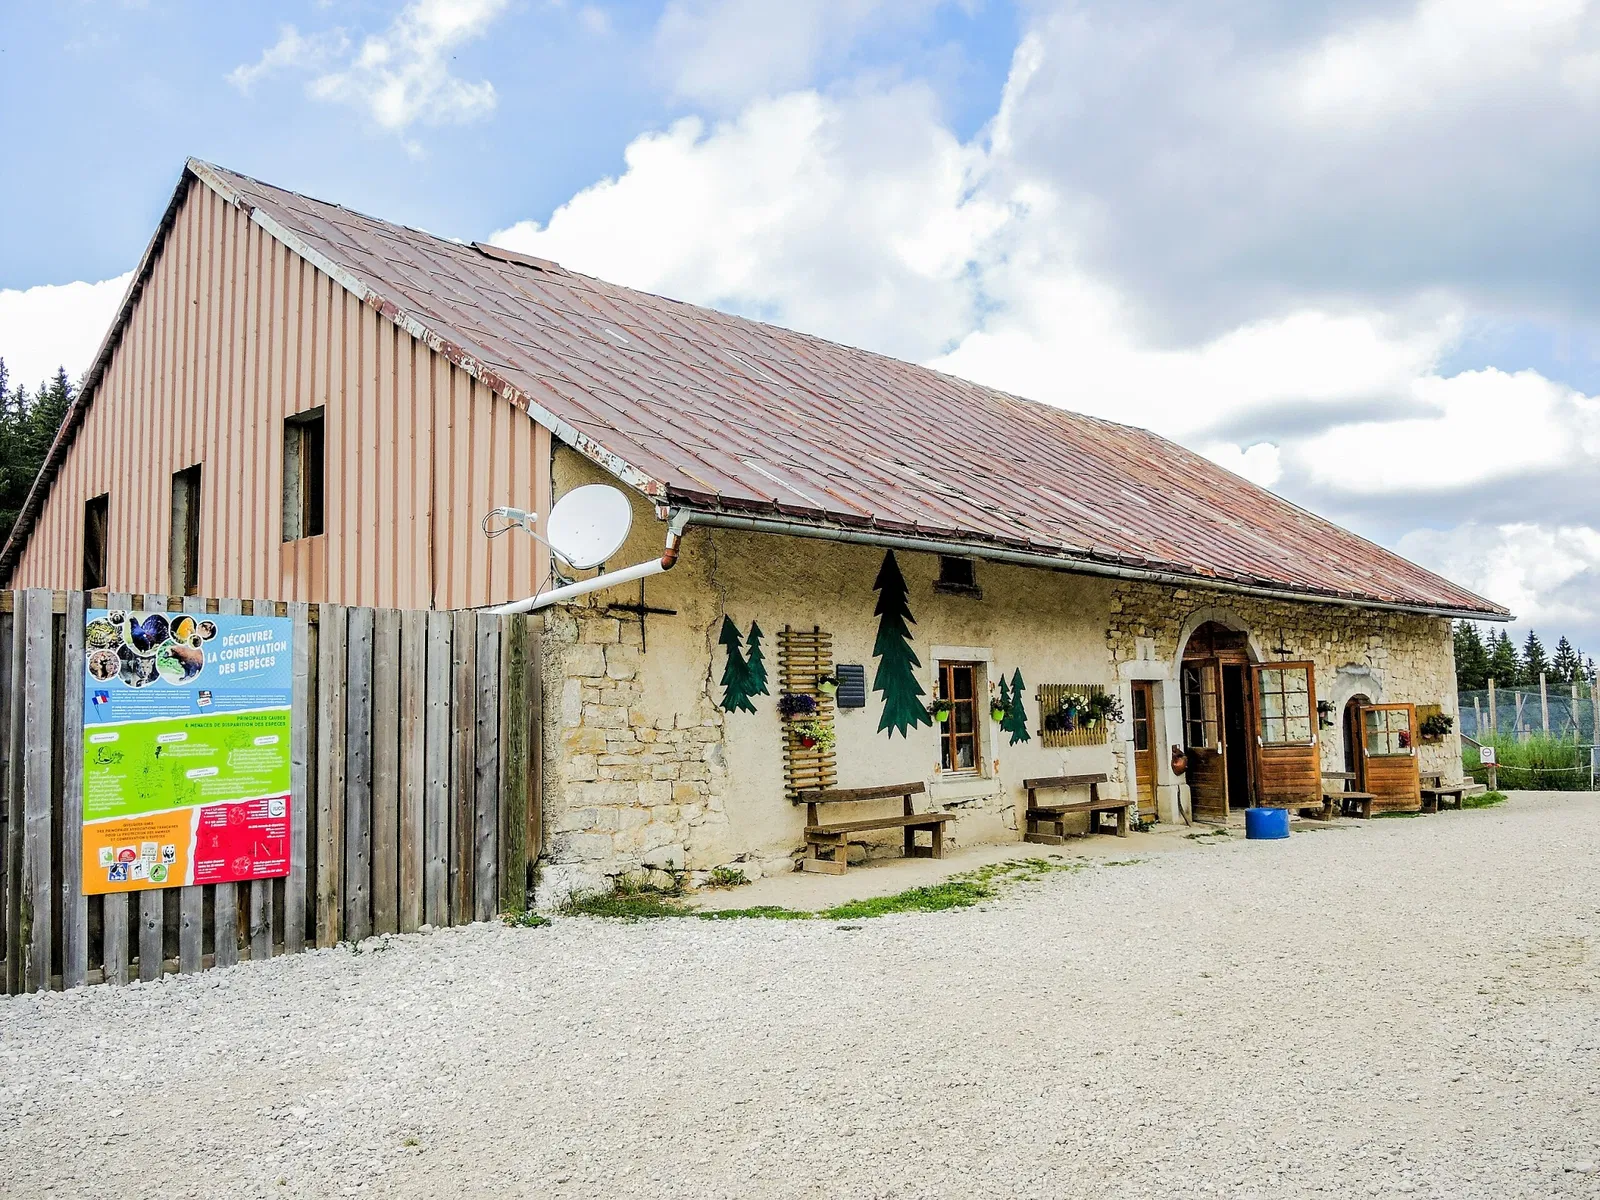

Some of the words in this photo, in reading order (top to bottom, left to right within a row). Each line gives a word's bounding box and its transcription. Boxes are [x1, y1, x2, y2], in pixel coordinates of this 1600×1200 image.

[222, 630, 273, 647] DÉCOUVREZ
[207, 652, 218, 663] LA
[220, 641, 287, 660] CONSERVATION
[219, 663, 236, 675] DES
[238, 656, 276, 672] ESPÈCES
